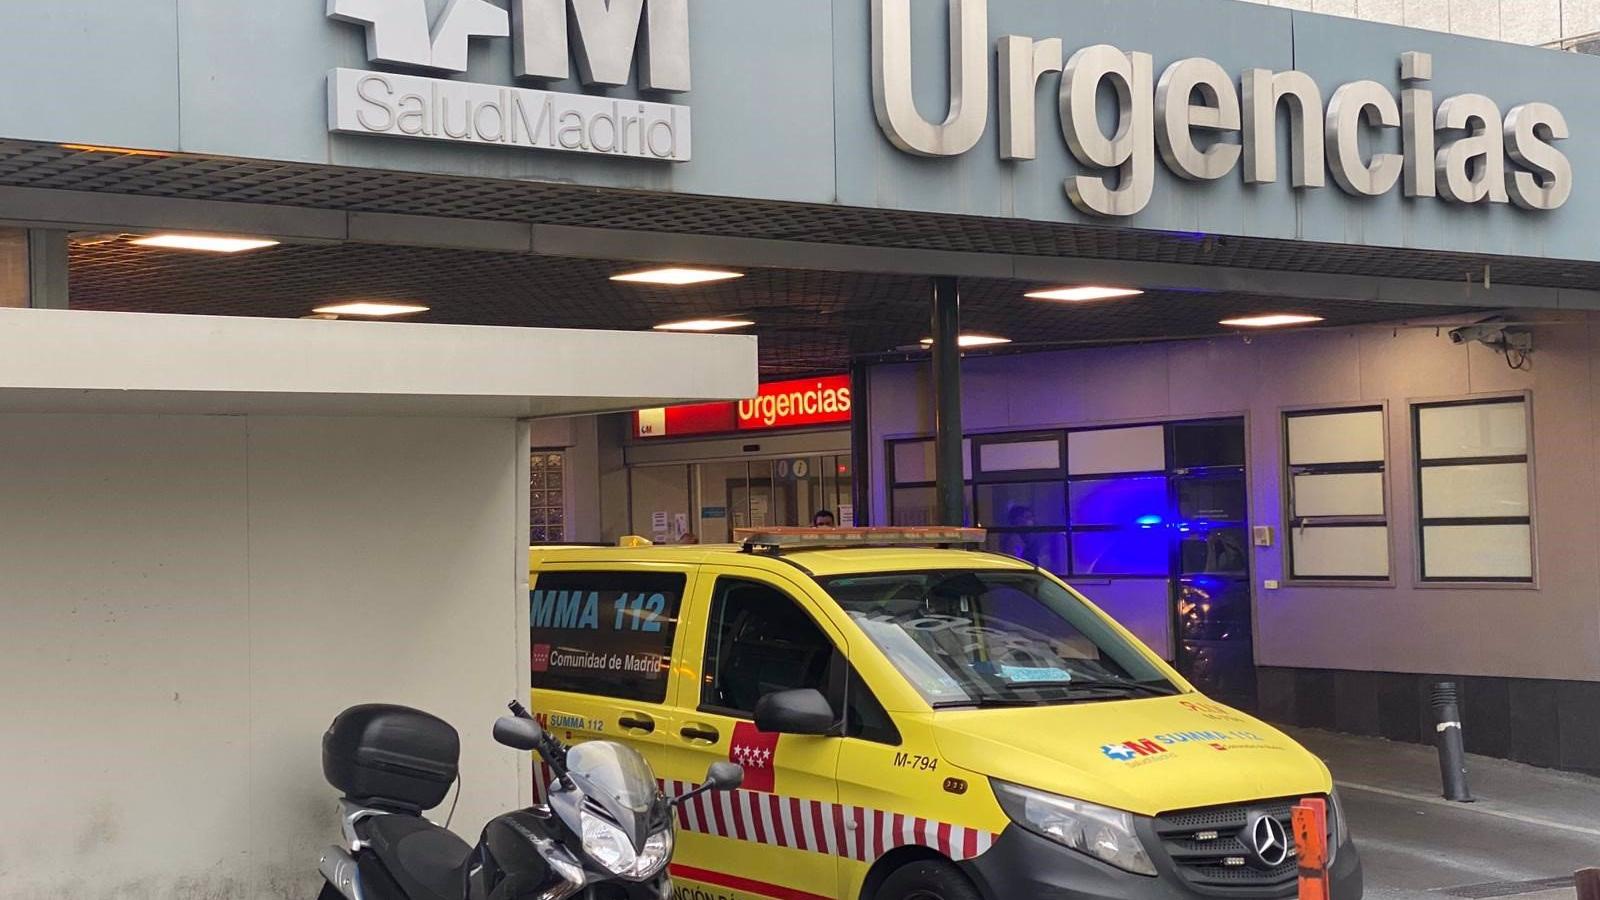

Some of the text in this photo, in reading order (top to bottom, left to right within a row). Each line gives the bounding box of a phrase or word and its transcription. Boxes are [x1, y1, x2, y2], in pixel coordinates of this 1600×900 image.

[355, 76, 677, 159] SaludMadrid
[872, 0, 1573, 217] Urgencias
[738, 383, 851, 425] Urgencias
[614, 592, 665, 632] 112
[550, 651, 661, 672] Comunidad de Madrid
[550, 714, 604, 731] SUMMA 112
[1121, 738, 1168, 756] M
[1154, 730, 1230, 744] SUMMA
[893, 752, 939, 771] M-794
